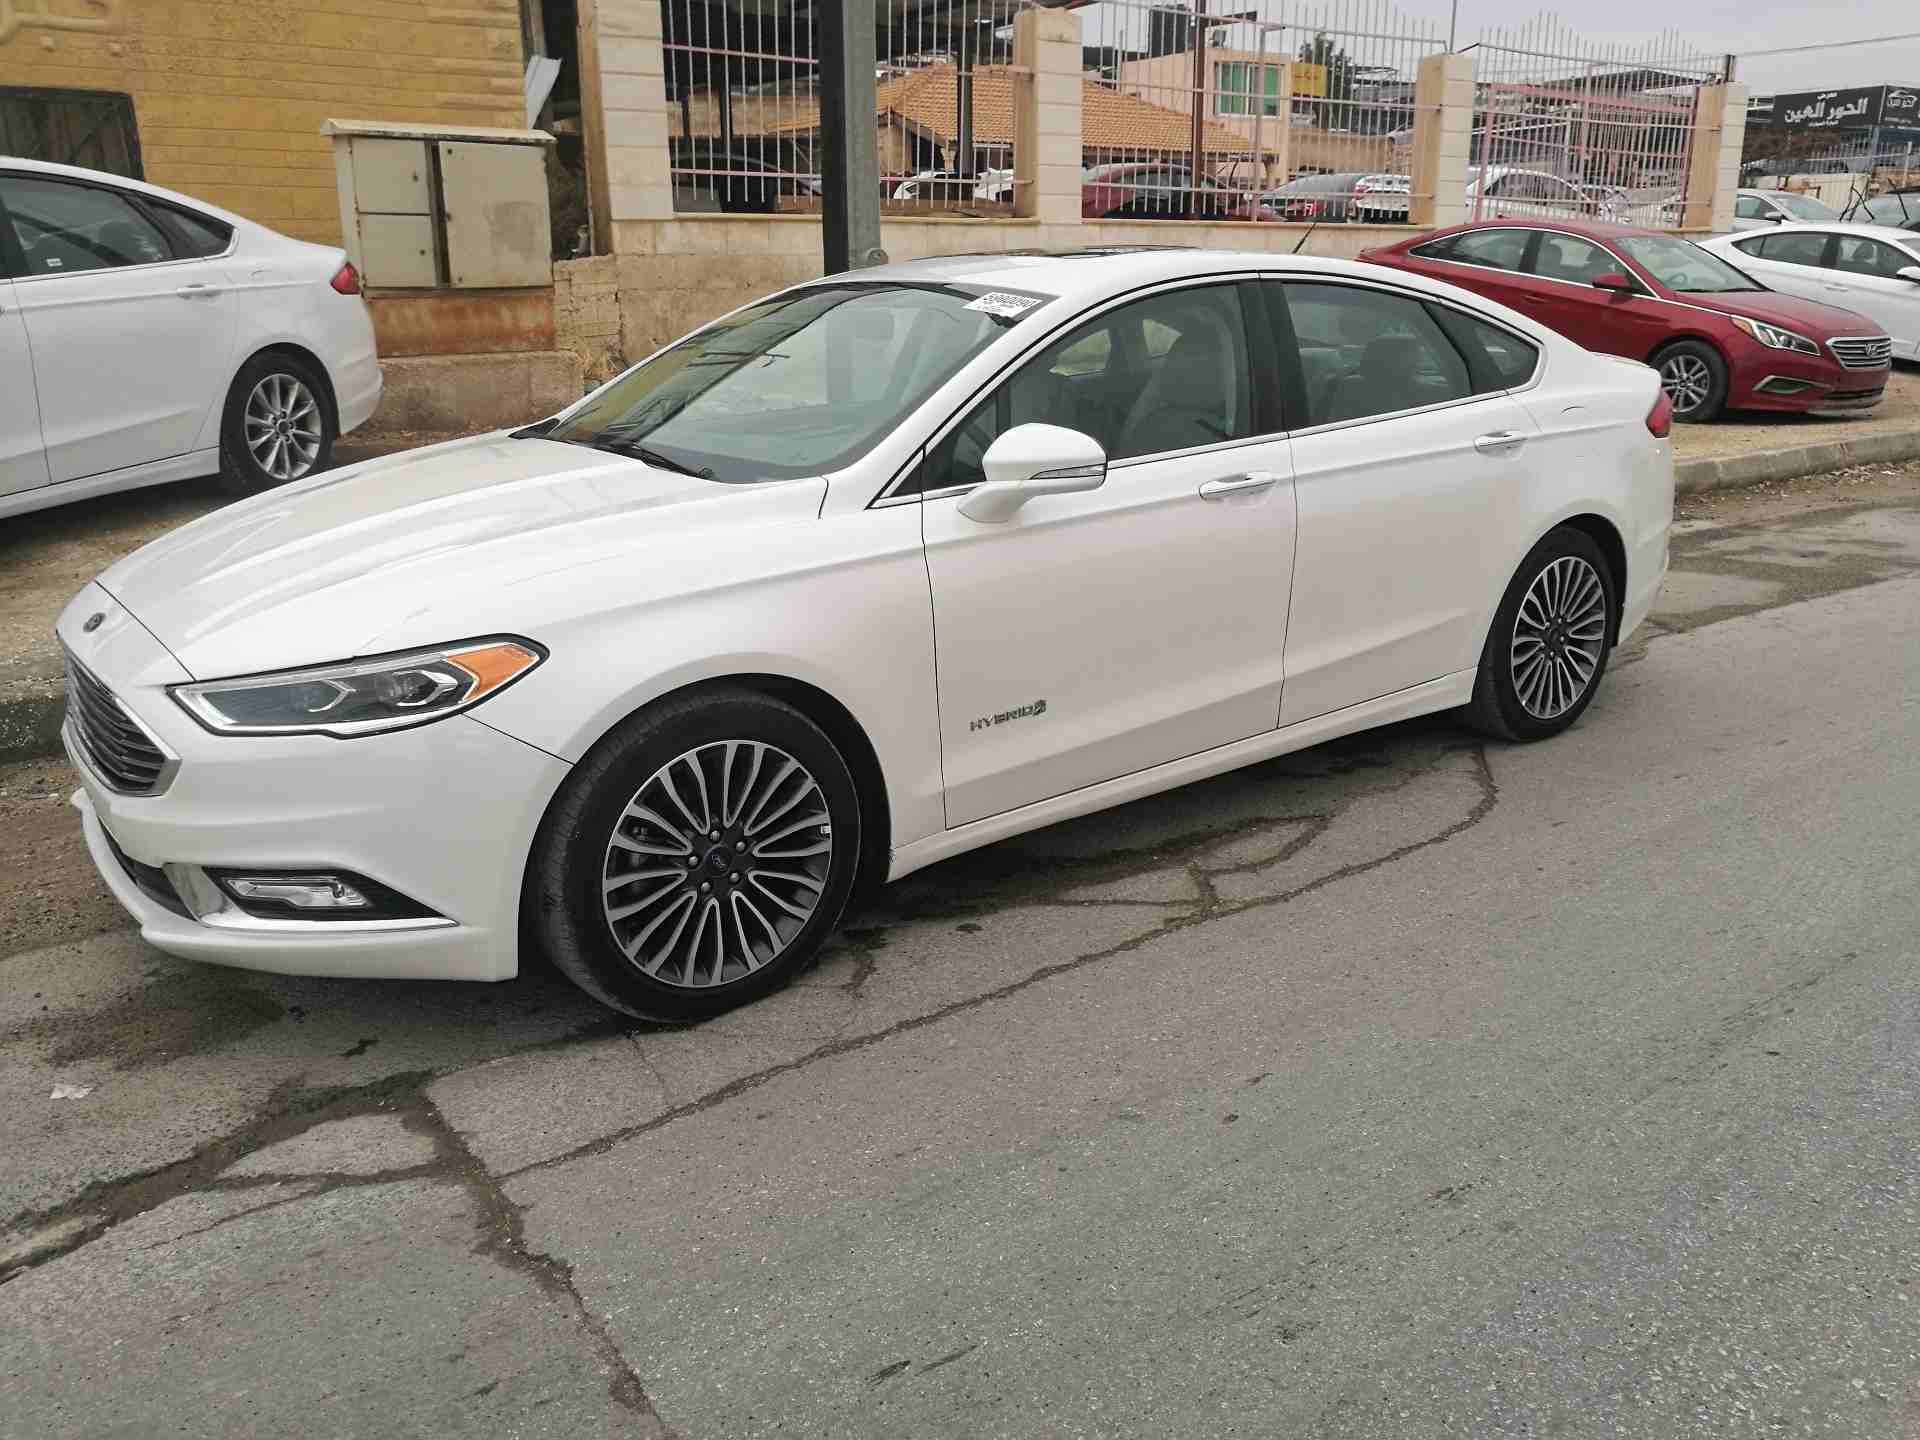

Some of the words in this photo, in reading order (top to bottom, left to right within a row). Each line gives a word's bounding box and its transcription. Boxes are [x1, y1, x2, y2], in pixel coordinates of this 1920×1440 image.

[1784, 101, 1826, 123] العين
[1826, 97, 1869, 120] الحور
[969, 704, 1034, 732] HYBRID
